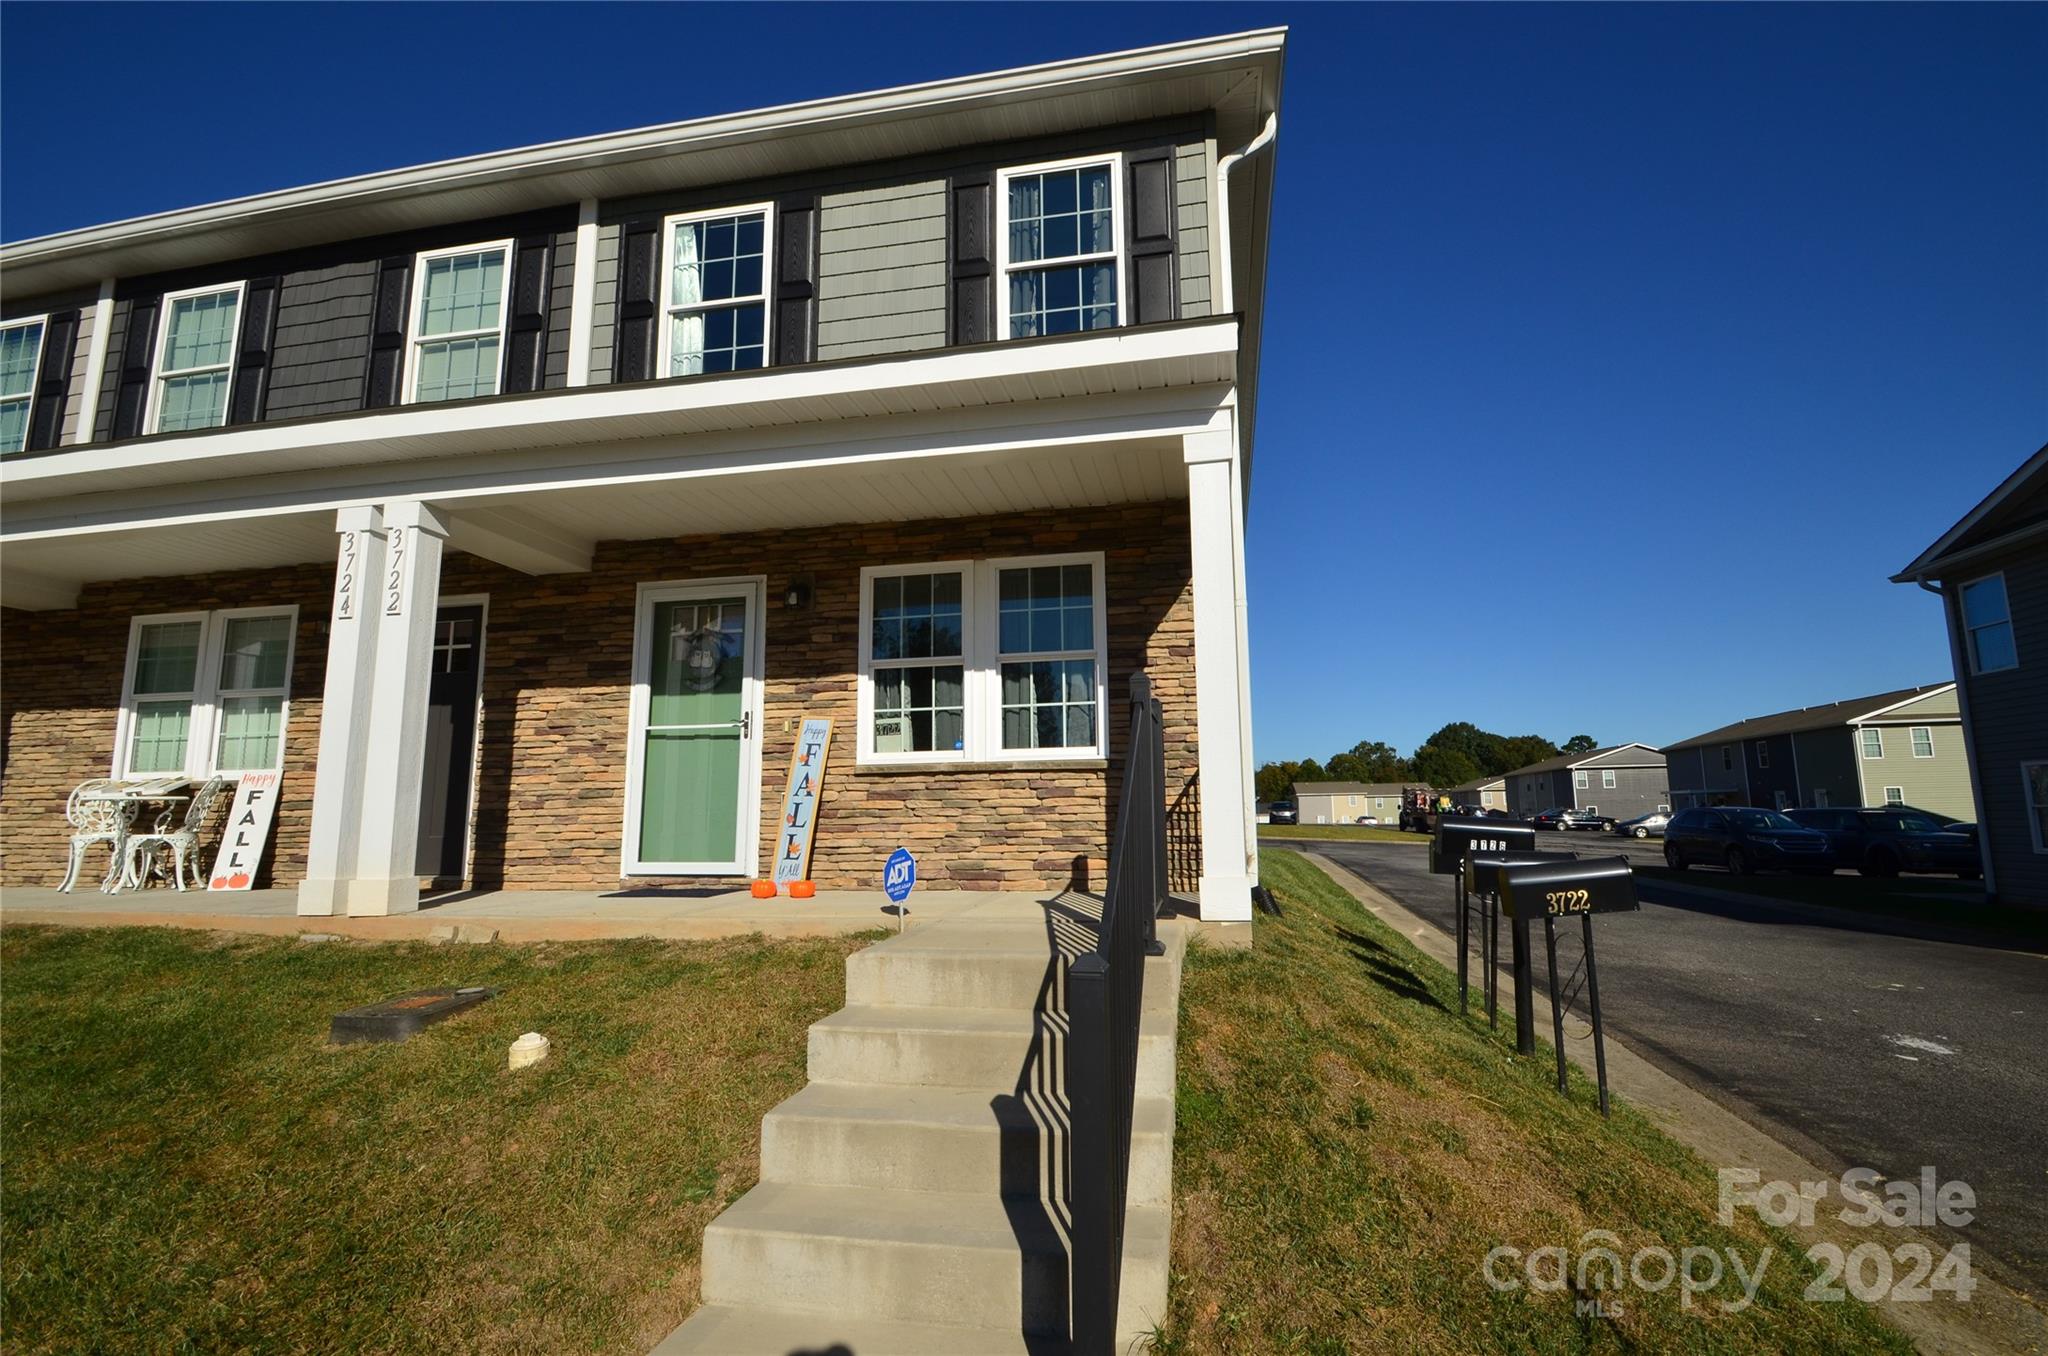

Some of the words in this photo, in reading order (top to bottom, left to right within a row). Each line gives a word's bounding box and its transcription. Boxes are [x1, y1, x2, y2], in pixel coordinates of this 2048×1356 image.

[339, 532, 355, 615] 3724
[387, 528, 403, 612] 3722
[803, 723, 827, 740] Happy
[241, 773, 277, 788] Happy
[783, 742, 821, 861] FALL
[229, 790, 264, 868] FALL
[886, 859, 912, 887] ADT
[1546, 889, 1591, 914] 3722
